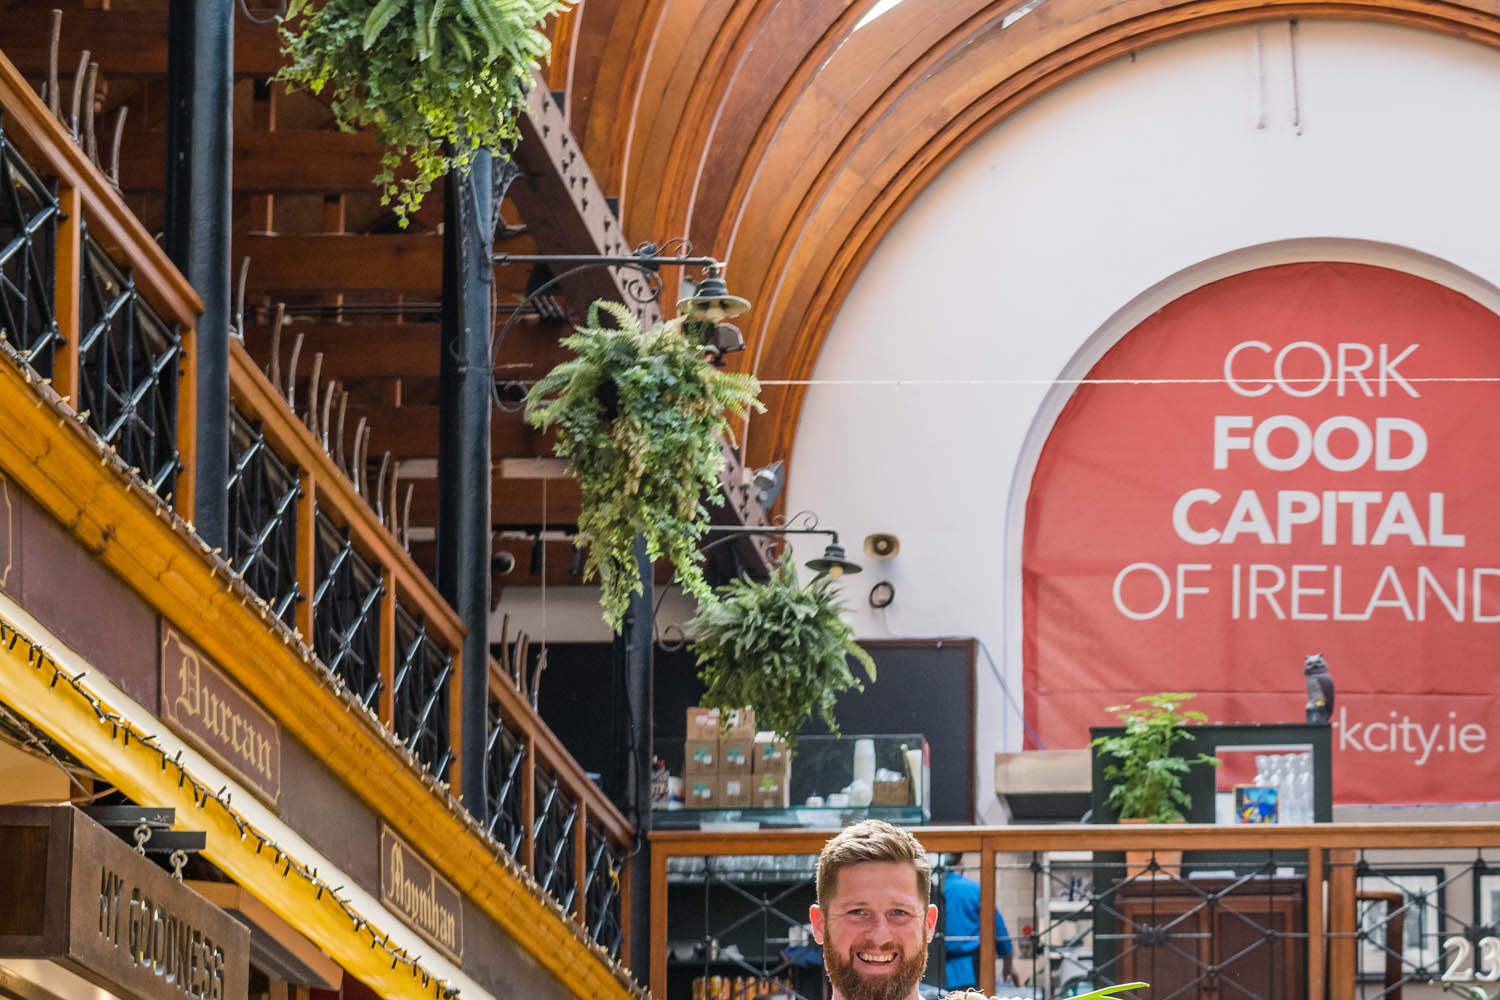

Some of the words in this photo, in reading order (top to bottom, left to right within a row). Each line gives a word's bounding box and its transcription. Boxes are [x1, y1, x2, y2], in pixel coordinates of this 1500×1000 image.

[1223, 339, 1422, 399] CORK
[1212, 414, 1429, 472] FOOD
[1171, 488, 1466, 548] CAPITAL
[1111, 561, 1213, 621] OF
[174, 653, 273, 781] Durcan
[99, 865, 125, 948] MY
